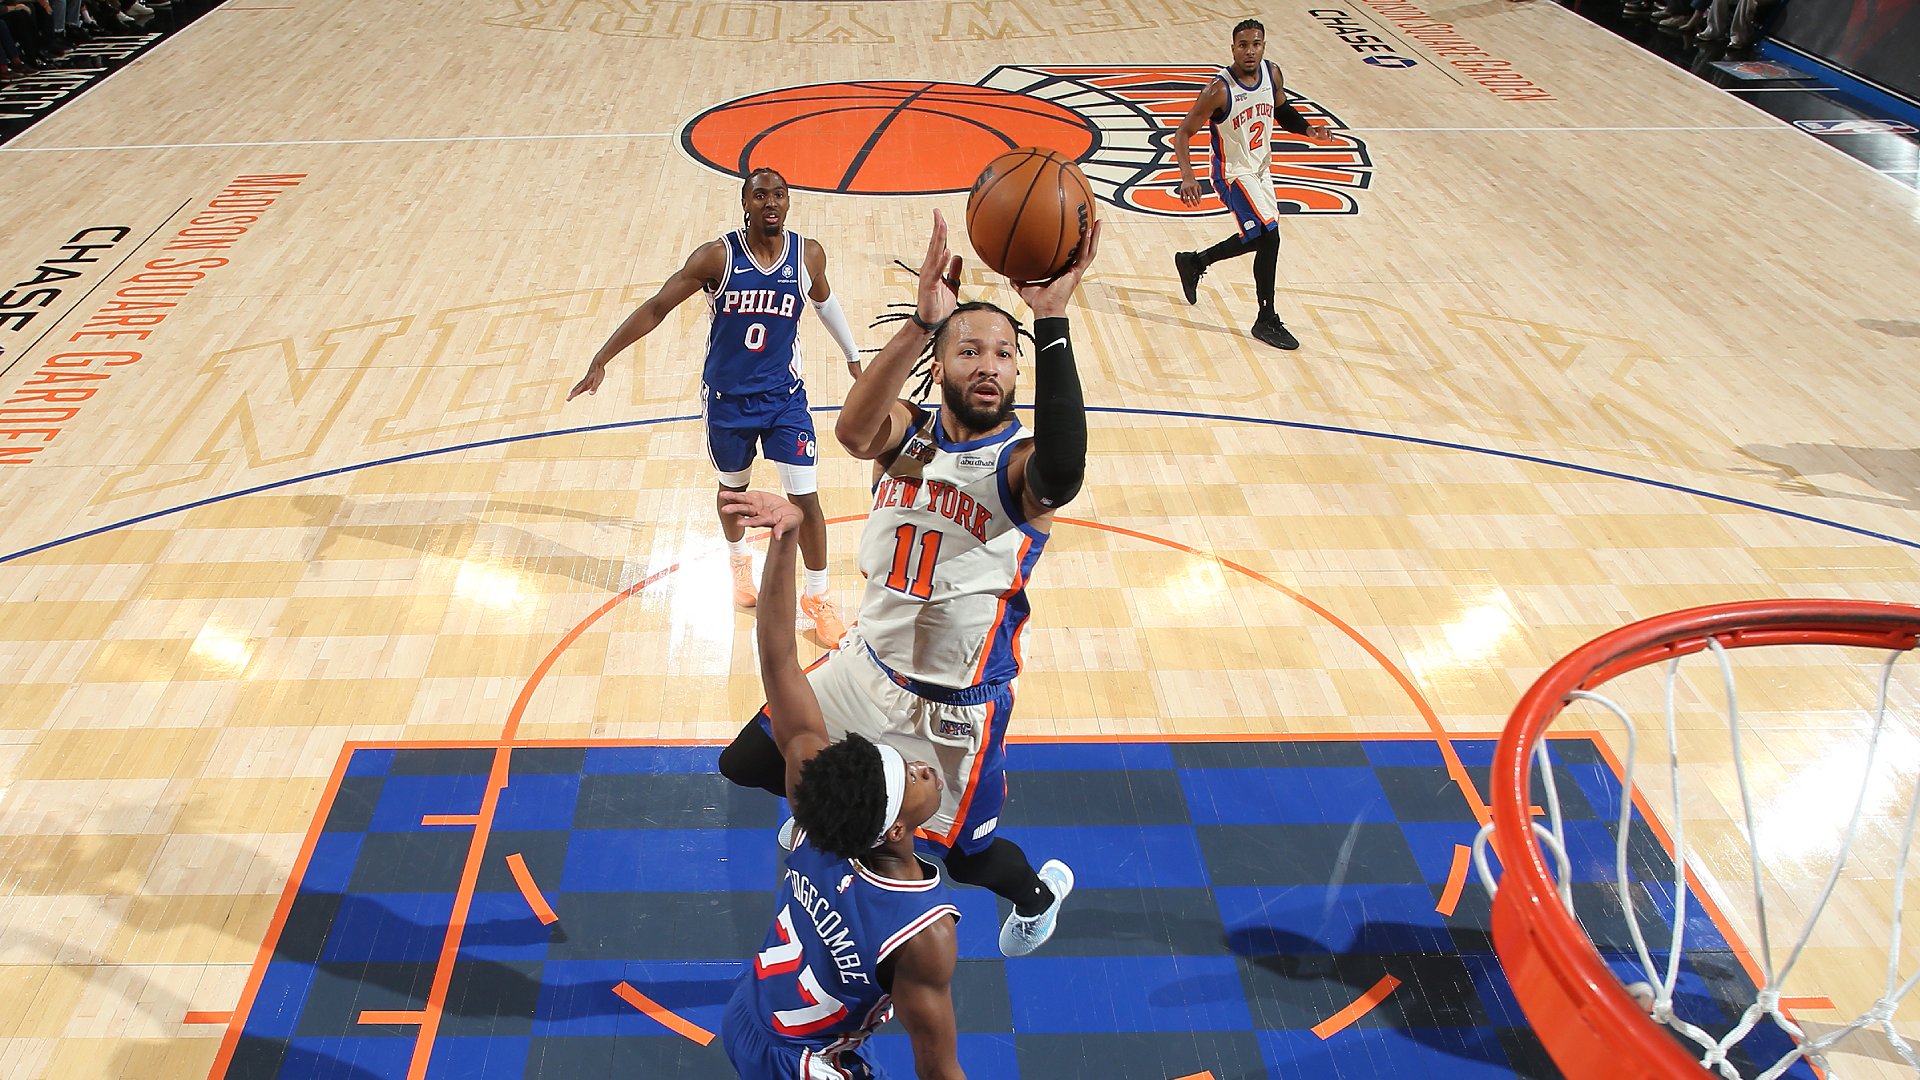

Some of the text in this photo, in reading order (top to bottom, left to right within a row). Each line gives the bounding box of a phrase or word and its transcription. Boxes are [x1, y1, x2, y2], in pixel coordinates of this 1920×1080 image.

[1308, 9, 1396, 53] CHASE
[1397, 23, 1490, 57] SQUARE
[1450, 59, 1558, 101] GARDEN
[1232, 107, 1253, 130] NEW
[1249, 121, 1264, 151] 2
[162, 174, 308, 251] MADISON
[68, 257, 230, 342] SQUARE
[722, 289, 797, 318] PHILA
[744, 323, 767, 352] 0
[796, 440, 815, 458] 76
[873, 476, 993, 545] NEW YORK
[885, 522, 943, 601] 11
[940, 719, 971, 736] NYC
[754, 903, 849, 1037] 77
